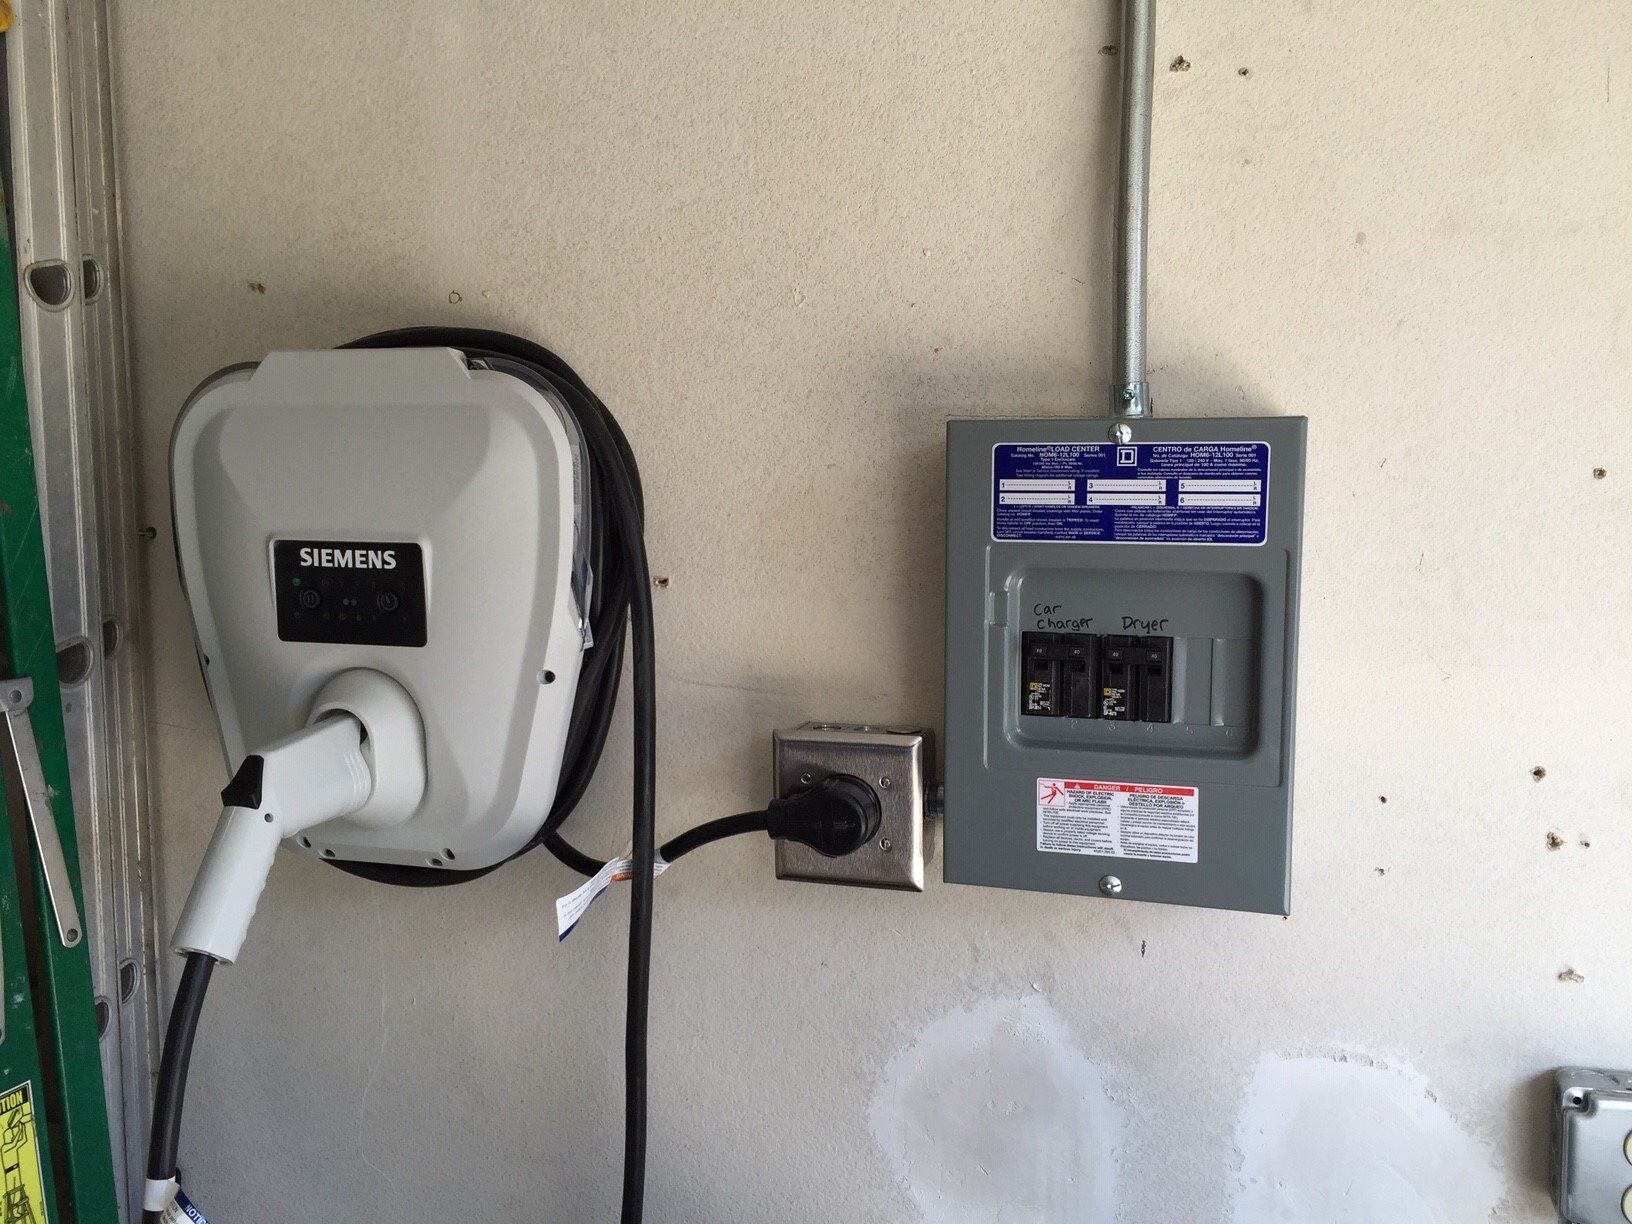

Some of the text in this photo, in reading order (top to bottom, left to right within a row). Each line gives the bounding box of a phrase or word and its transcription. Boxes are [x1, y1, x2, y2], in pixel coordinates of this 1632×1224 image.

[300, 547, 397, 570] SIEMENS
[1033, 603, 1062, 617] Car
[1121, 616, 1169, 634] Dryer
[1093, 784, 1120, 792] DANGER
[0, 1090, 23, 1113] TION
